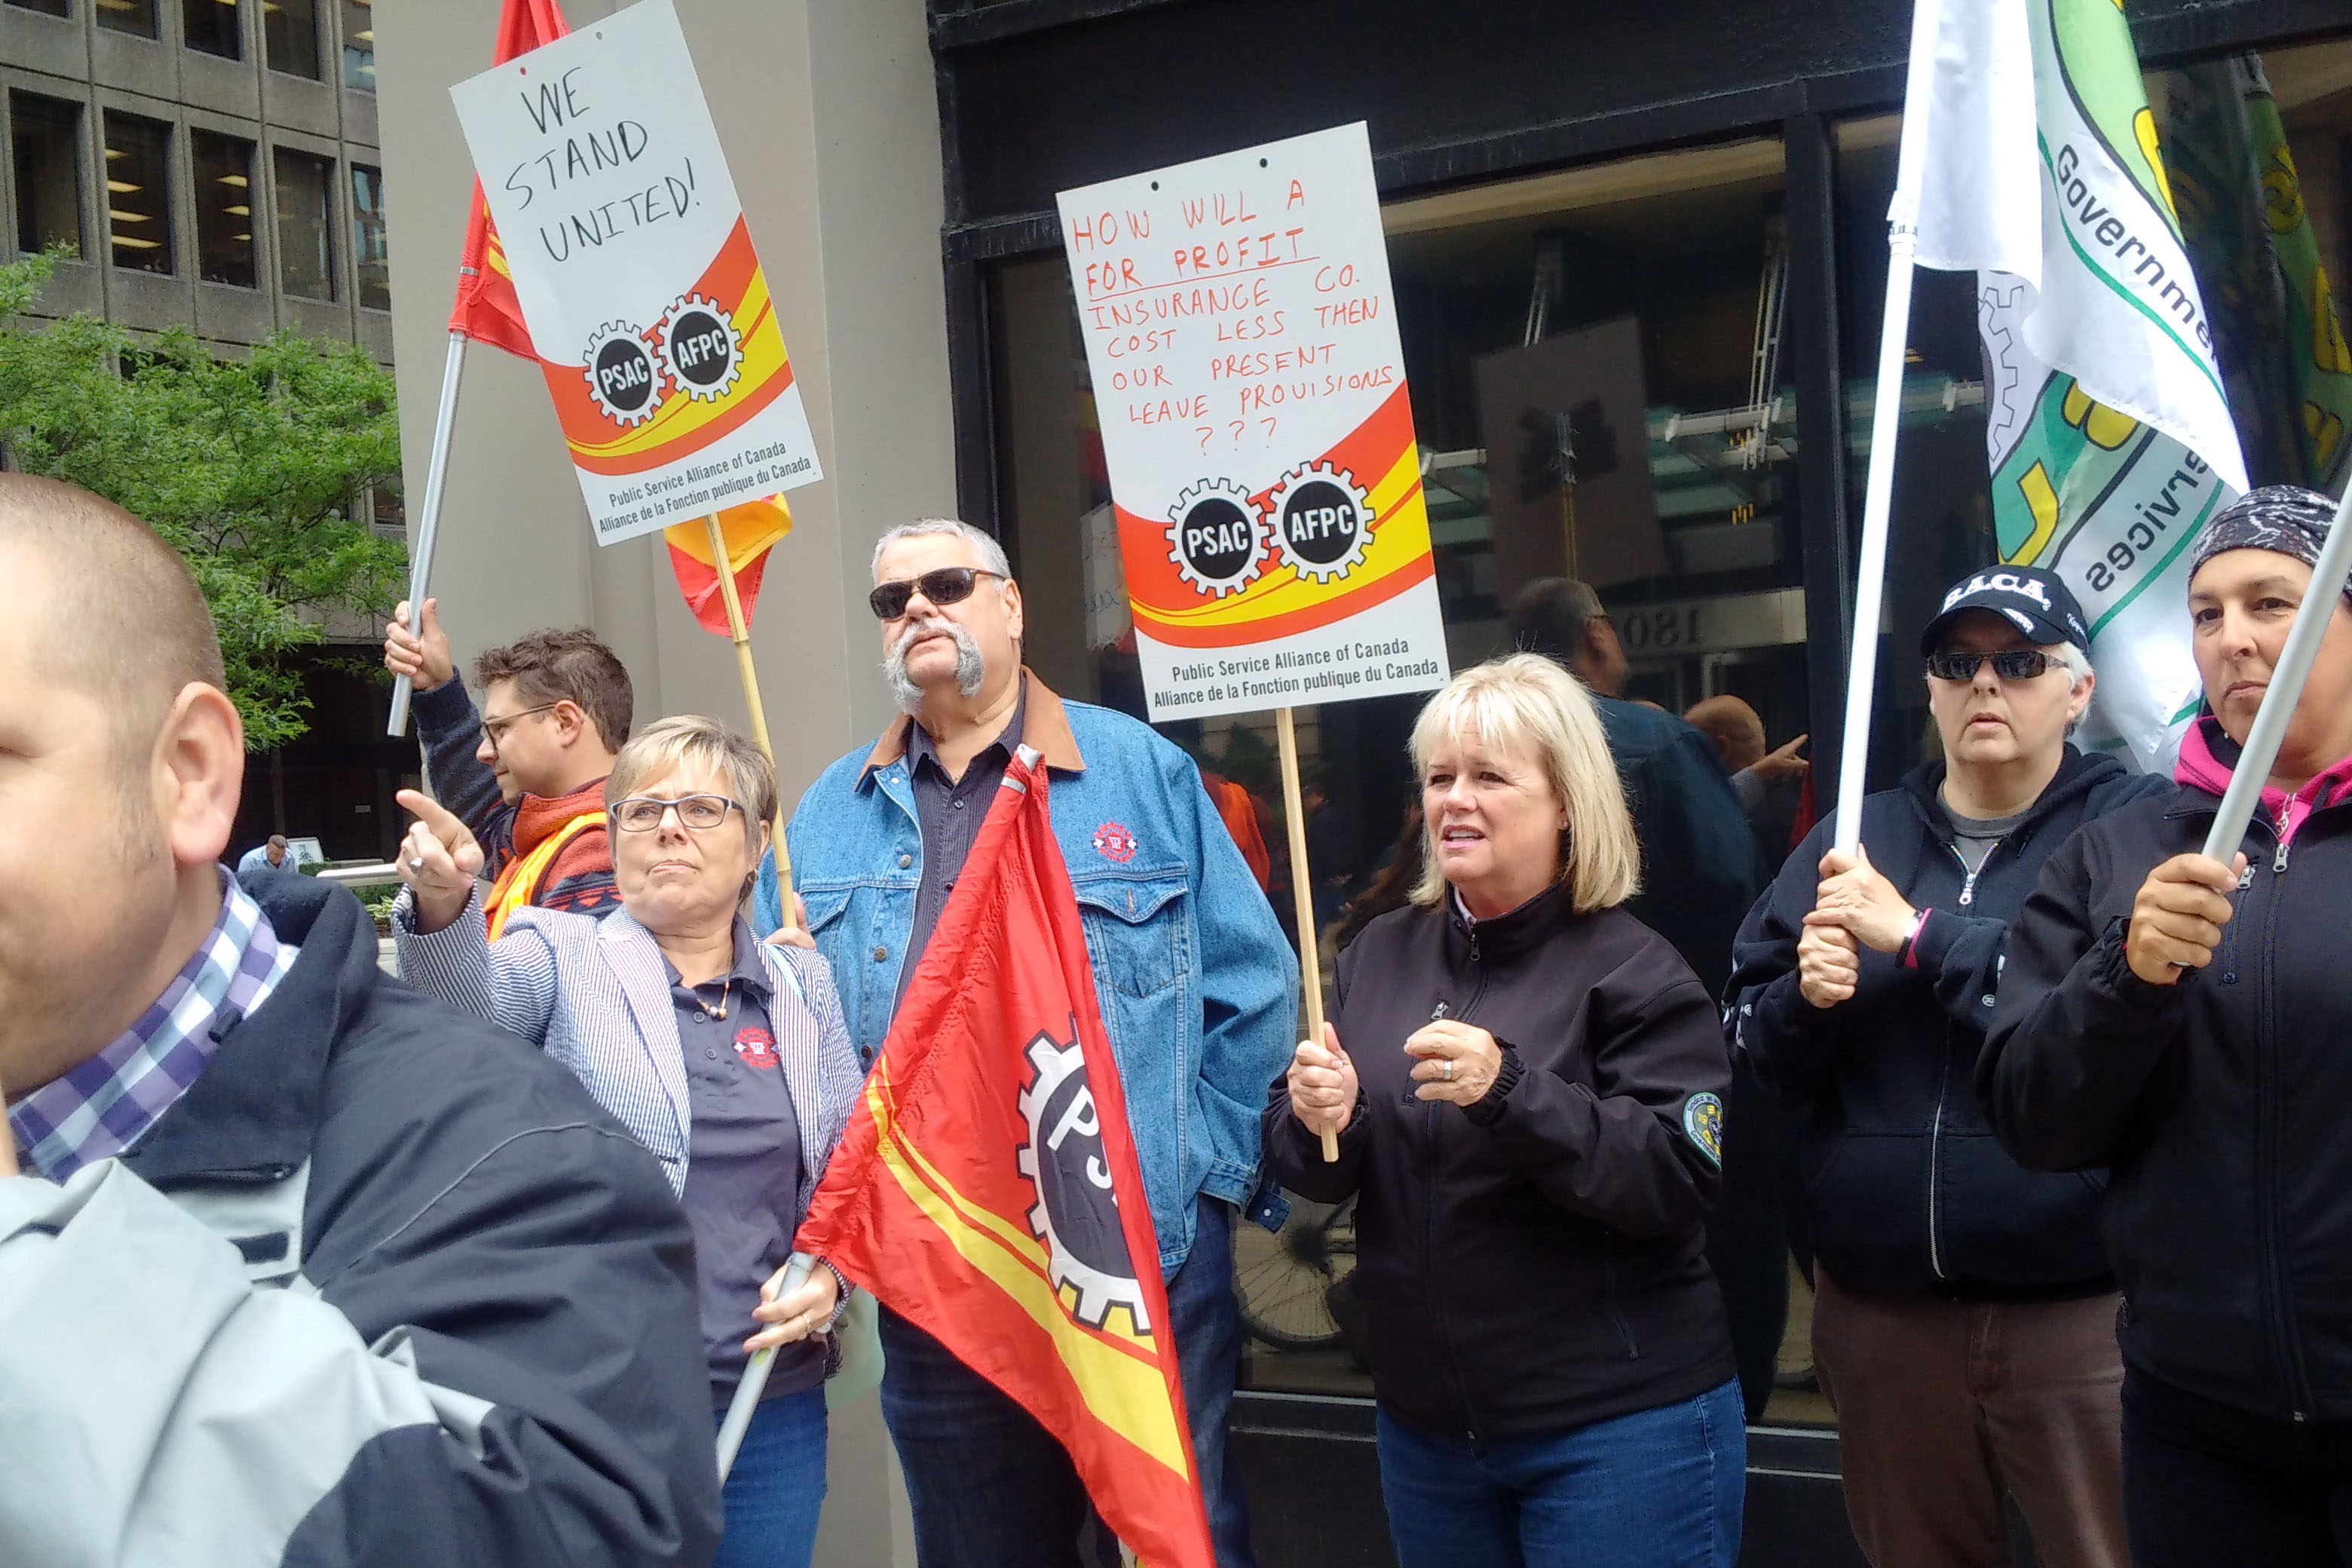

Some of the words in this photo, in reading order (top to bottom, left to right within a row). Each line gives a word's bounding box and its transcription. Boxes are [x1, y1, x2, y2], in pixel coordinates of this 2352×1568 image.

[521, 67, 590, 134] WE
[506, 121, 648, 210] STAND
[540, 157, 700, 262] UNITED!
[1073, 210, 1150, 253] HOW
[1182, 191, 1257, 229] WILL
[1287, 179, 1304, 210] A
[1086, 258, 1143, 296] FOR
[1174, 227, 1303, 277] PROFIT
[2057, 144, 2216, 362] Governme
[1087, 277, 1270, 329] INSURANCE
[1315, 264, 1360, 292] CO.
[1107, 329, 1177, 358] COST
[1217, 311, 1285, 341] LESS
[1314, 296, 1378, 329] THEN
[600, 357, 648, 395] PSAC
[678, 329, 727, 369] AFPC
[1112, 364, 1172, 390] OUR
[1211, 344, 1337, 381] PRESENT
[1129, 395, 1209, 424] LEAVE
[599, 512, 639, 533] Alliance
[640, 505, 654, 521] de
[654, 501, 665, 516] la
[666, 490, 709, 513] Fonction
[712, 477, 755, 501] publique
[757, 469, 770, 485] du
[771, 456, 812, 479] Canada
[609, 486, 643, 507] Public
[645, 474, 684, 497] Service
[686, 460, 730, 484] Alliance
[732, 453, 744, 469] of
[745, 441, 786, 464] Canada
[1186, 521, 1248, 558] PSAC
[1291, 504, 1354, 543] AFPC
[1154, 687, 1204, 708] Alliance
[1208, 684, 1223, 702] de
[1227, 681, 1239, 699] la
[1242, 675, 1300, 698] Fonction
[1303, 668, 1361, 693] publique
[1365, 665, 1382, 681] du
[1386, 658, 1439, 680] Canada
[1171, 663, 1214, 682] Public
[1218, 657, 1270, 675] Service
[1275, 649, 1331, 669] Alliance
[1336, 645, 1350, 661] of
[1354, 638, 1409, 660] Canada
